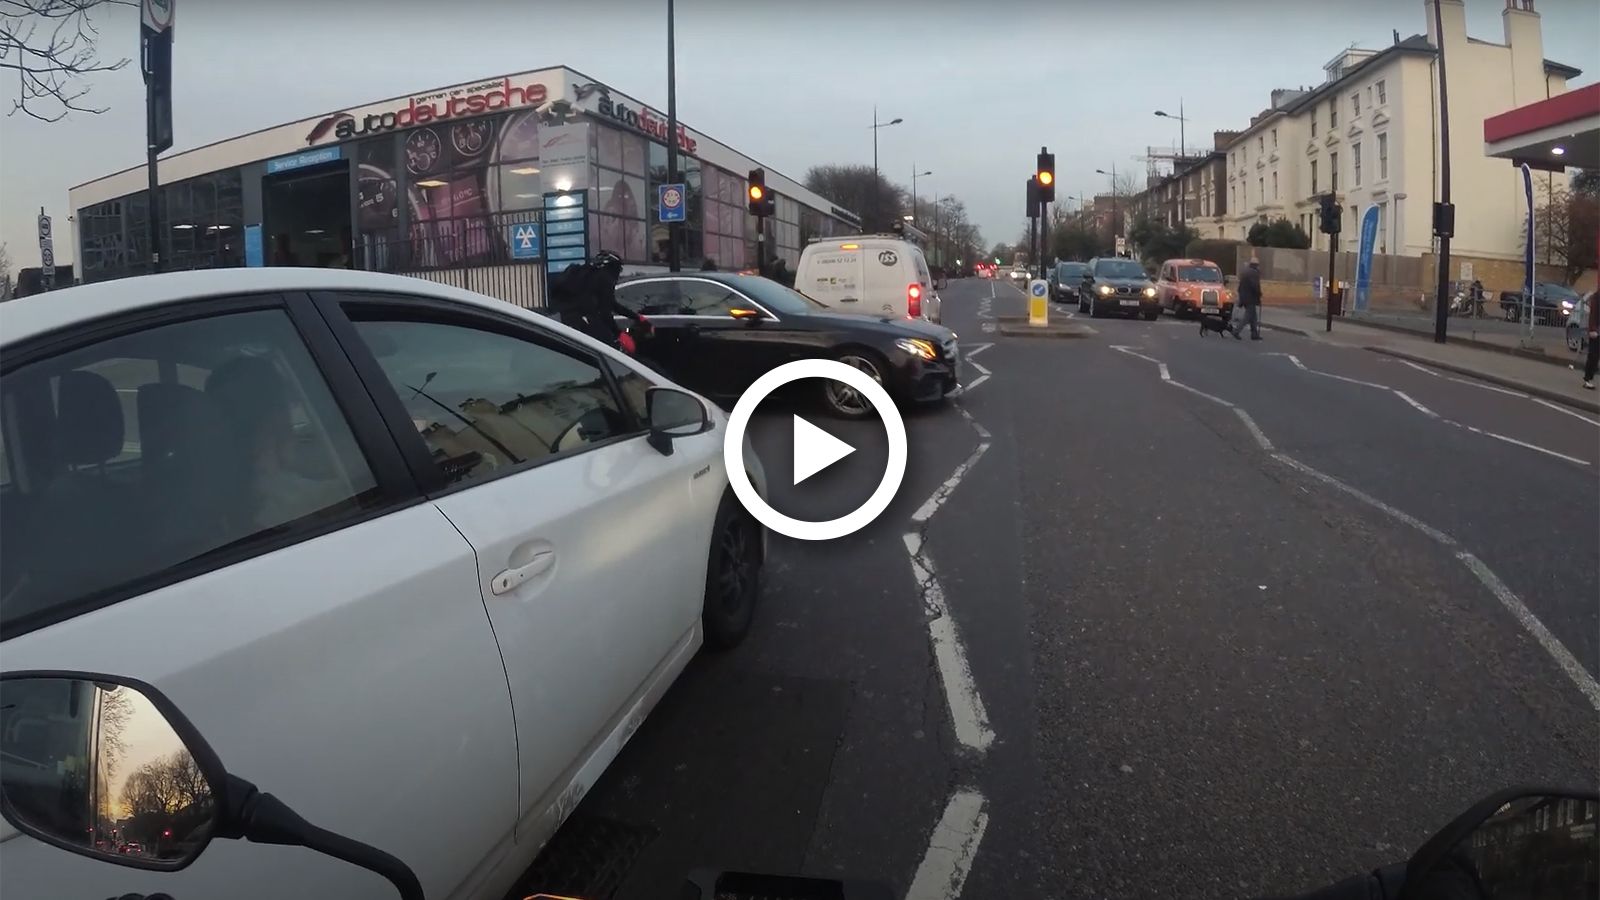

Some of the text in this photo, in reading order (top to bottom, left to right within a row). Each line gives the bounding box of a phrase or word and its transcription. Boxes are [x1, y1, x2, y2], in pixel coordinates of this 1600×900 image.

[416, 91, 447, 104] german
[450, 88, 464, 97] car
[274, 152, 333, 171] Service Reception
